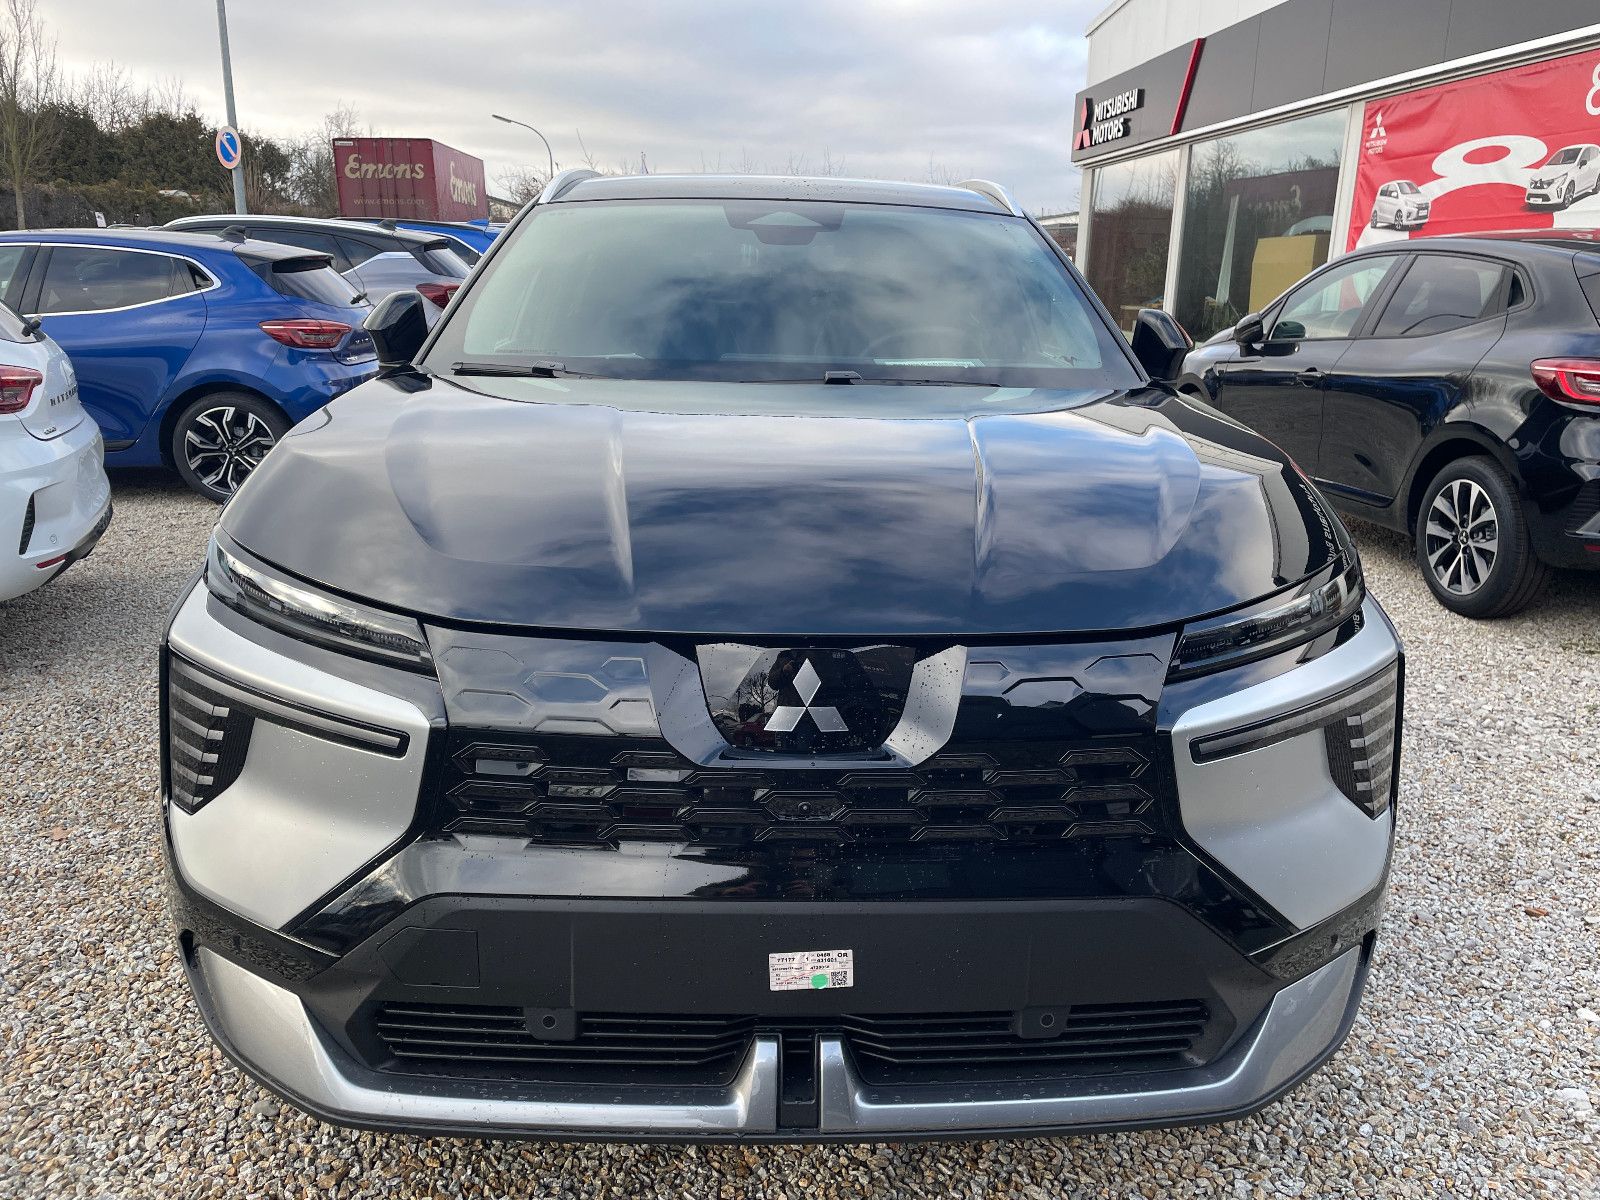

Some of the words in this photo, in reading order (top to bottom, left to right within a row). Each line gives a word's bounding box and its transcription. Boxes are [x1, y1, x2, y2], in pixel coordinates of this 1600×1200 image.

[1094, 88, 1138, 122] MITSUBISHI
[1091, 117, 1124, 145] MOTORS
[344, 153, 425, 180] Emons
[450, 161, 477, 207] Emons
